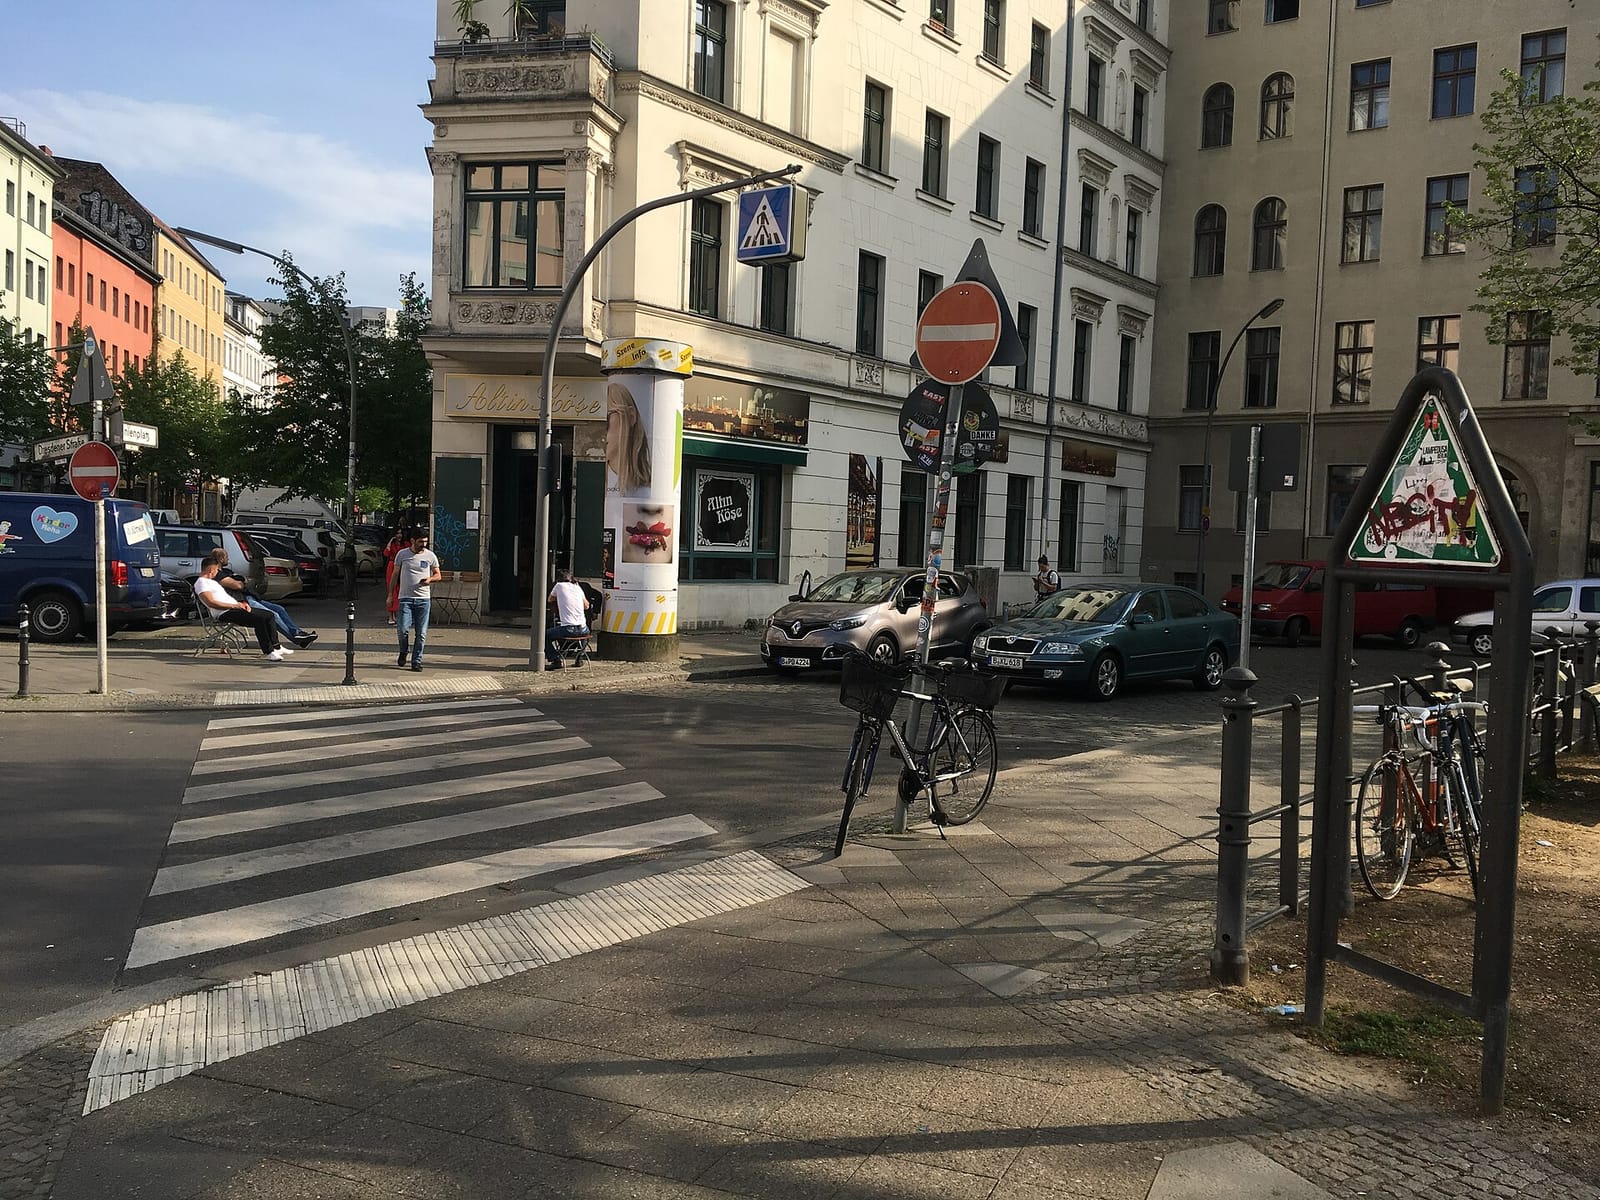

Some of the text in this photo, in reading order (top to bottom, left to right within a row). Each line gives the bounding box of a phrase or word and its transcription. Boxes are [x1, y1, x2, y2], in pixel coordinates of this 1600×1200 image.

[616, 342, 635, 358] Szene
[631, 349, 647, 361] Info
[971, 430, 995, 440] DANKE
[37, 441, 66, 456] Dresdener
[36, 513, 71, 529] Kinder
[40, 523, 61, 535] Reha
